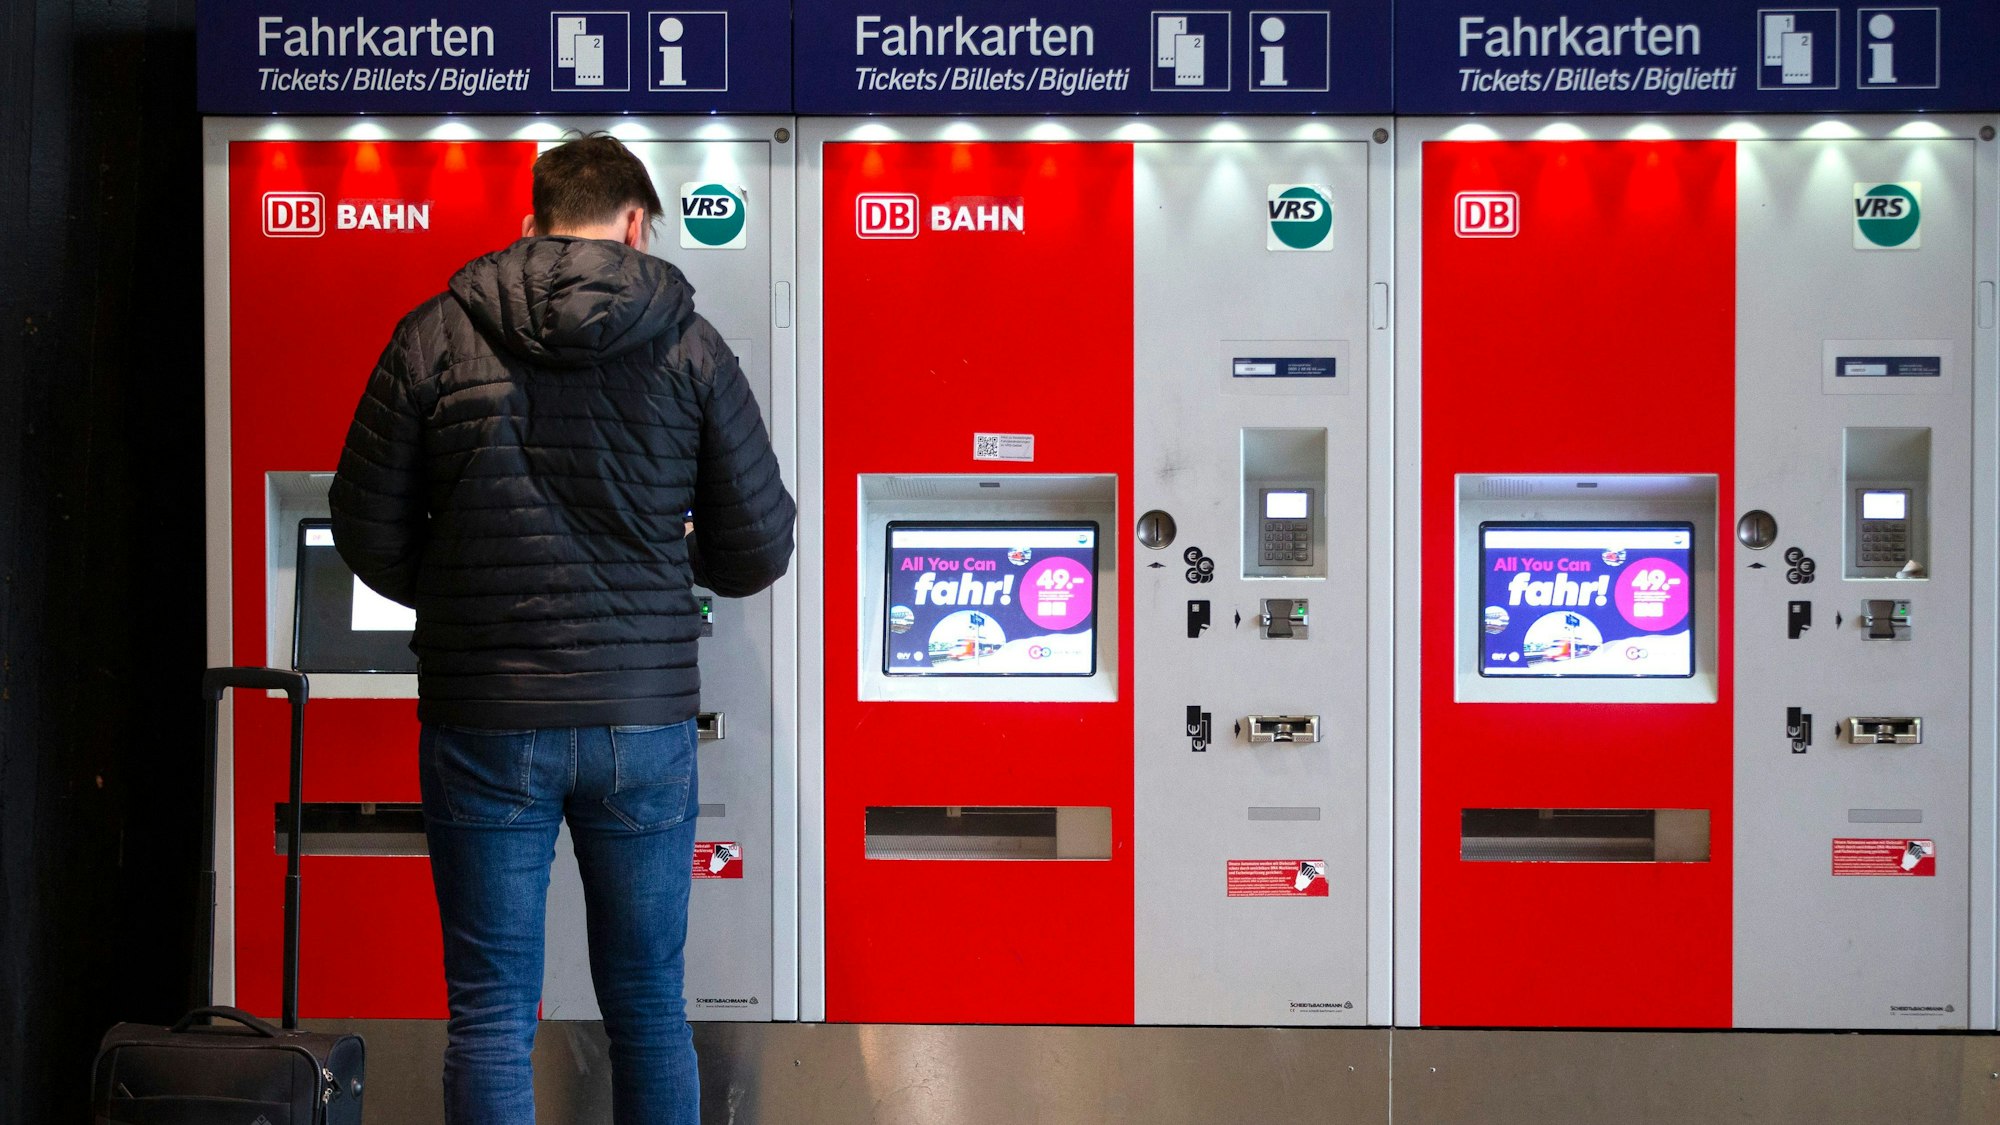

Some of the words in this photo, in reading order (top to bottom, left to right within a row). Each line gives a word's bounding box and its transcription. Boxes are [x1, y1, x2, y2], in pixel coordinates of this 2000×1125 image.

[259, 17, 493, 56] Fahrkarten
[857, 16, 1093, 56] Fahrkarten
[1460, 17, 1699, 57] Fahrkarten
[272, 201, 316, 229] DB
[338, 205, 429, 230] BAHN
[681, 197, 728, 217] VRS
[866, 202, 910, 230] DB
[931, 206, 1024, 231] BAHN
[1269, 200, 1317, 219] VRS
[1465, 201, 1509, 229] DB
[1856, 198, 1903, 217] VRS
[902, 557, 923, 571] All
[928, 557, 960, 571] You
[964, 557, 996, 571] Can
[1494, 557, 1517, 571] All
[1521, 558, 1553, 571] You
[1557, 557, 1590, 571] Can
[914, 572, 1014, 605] fahr!
[1508, 572, 1610, 606] fahr!
